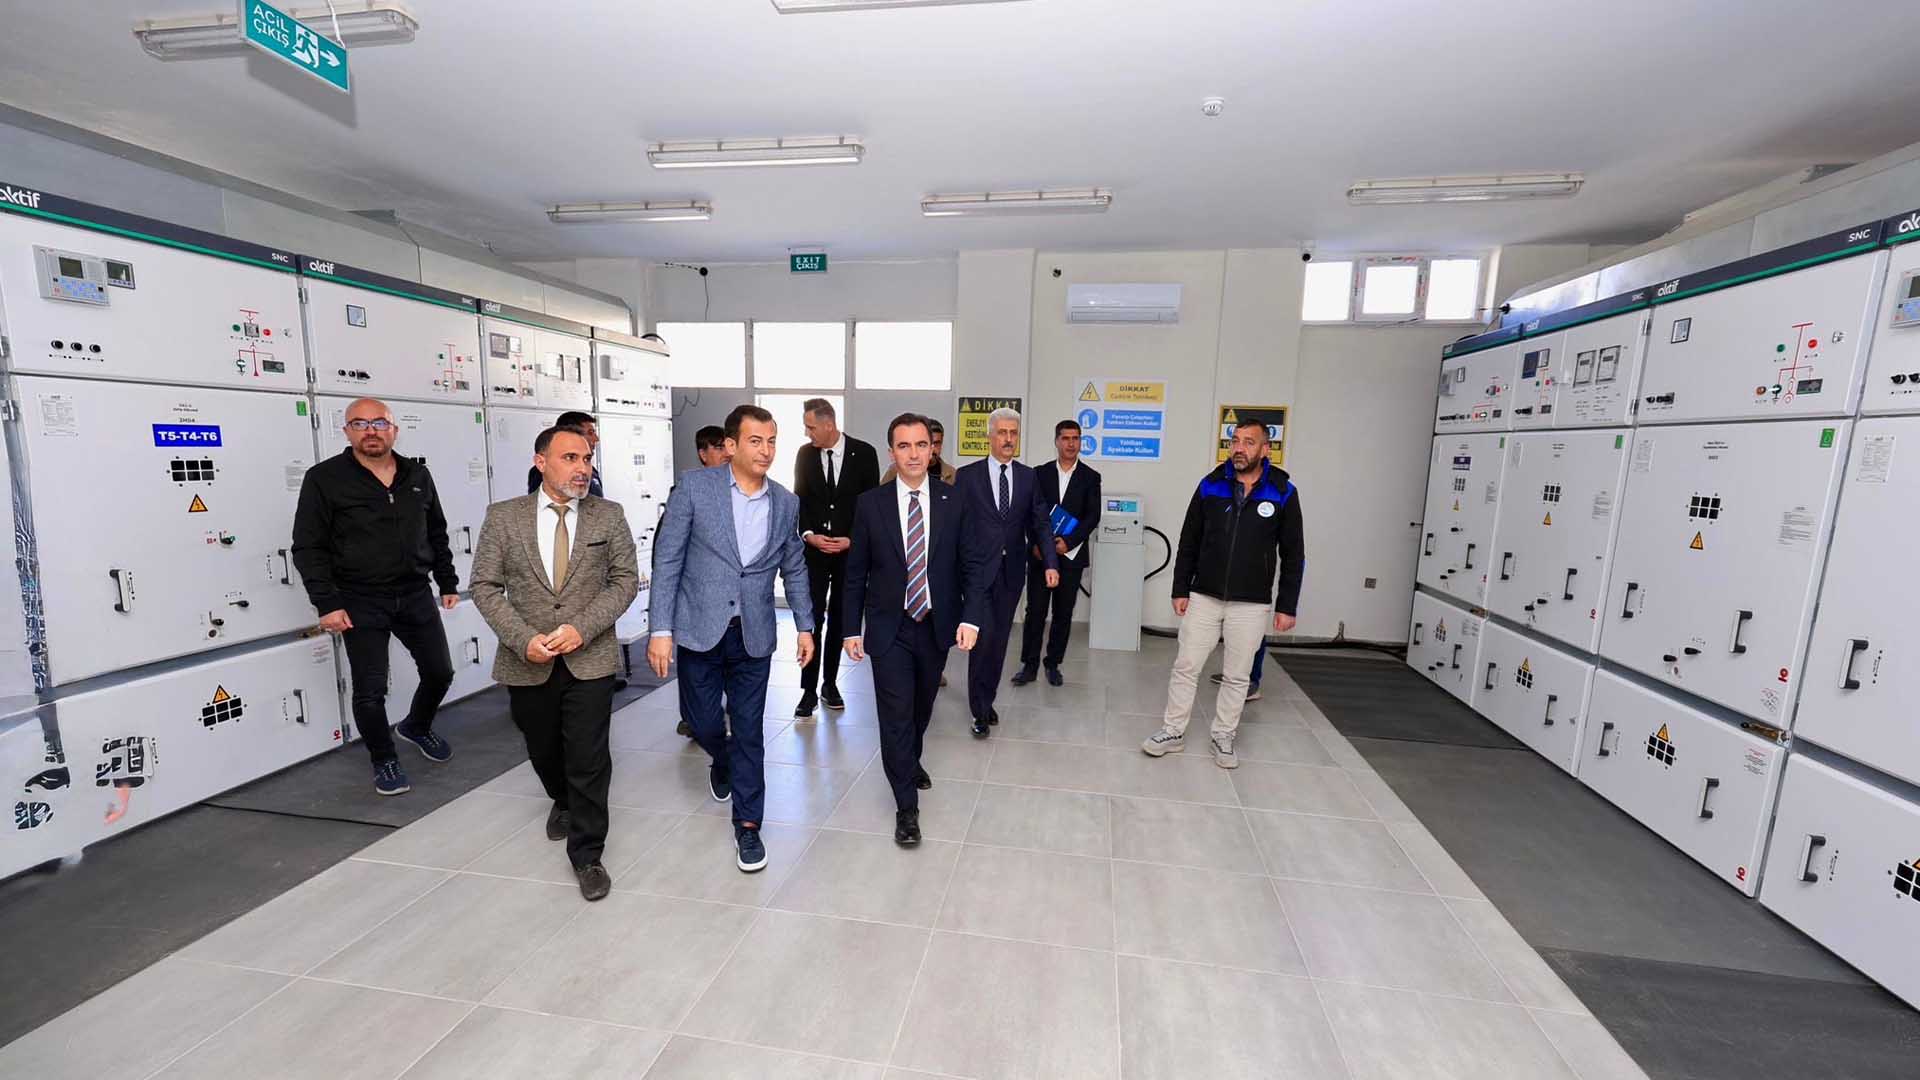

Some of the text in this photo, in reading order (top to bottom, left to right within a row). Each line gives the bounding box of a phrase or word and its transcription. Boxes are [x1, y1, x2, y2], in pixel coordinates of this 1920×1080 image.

[253, 18, 290, 48] ÇIKIŞ
[1848, 228, 1871, 242] SNC
[271, 252, 289, 263] SNC
[309, 260, 335, 275] aktif
[974, 399, 1018, 410] DİKKAT
[157, 431, 218, 441] T5-T4-T6
